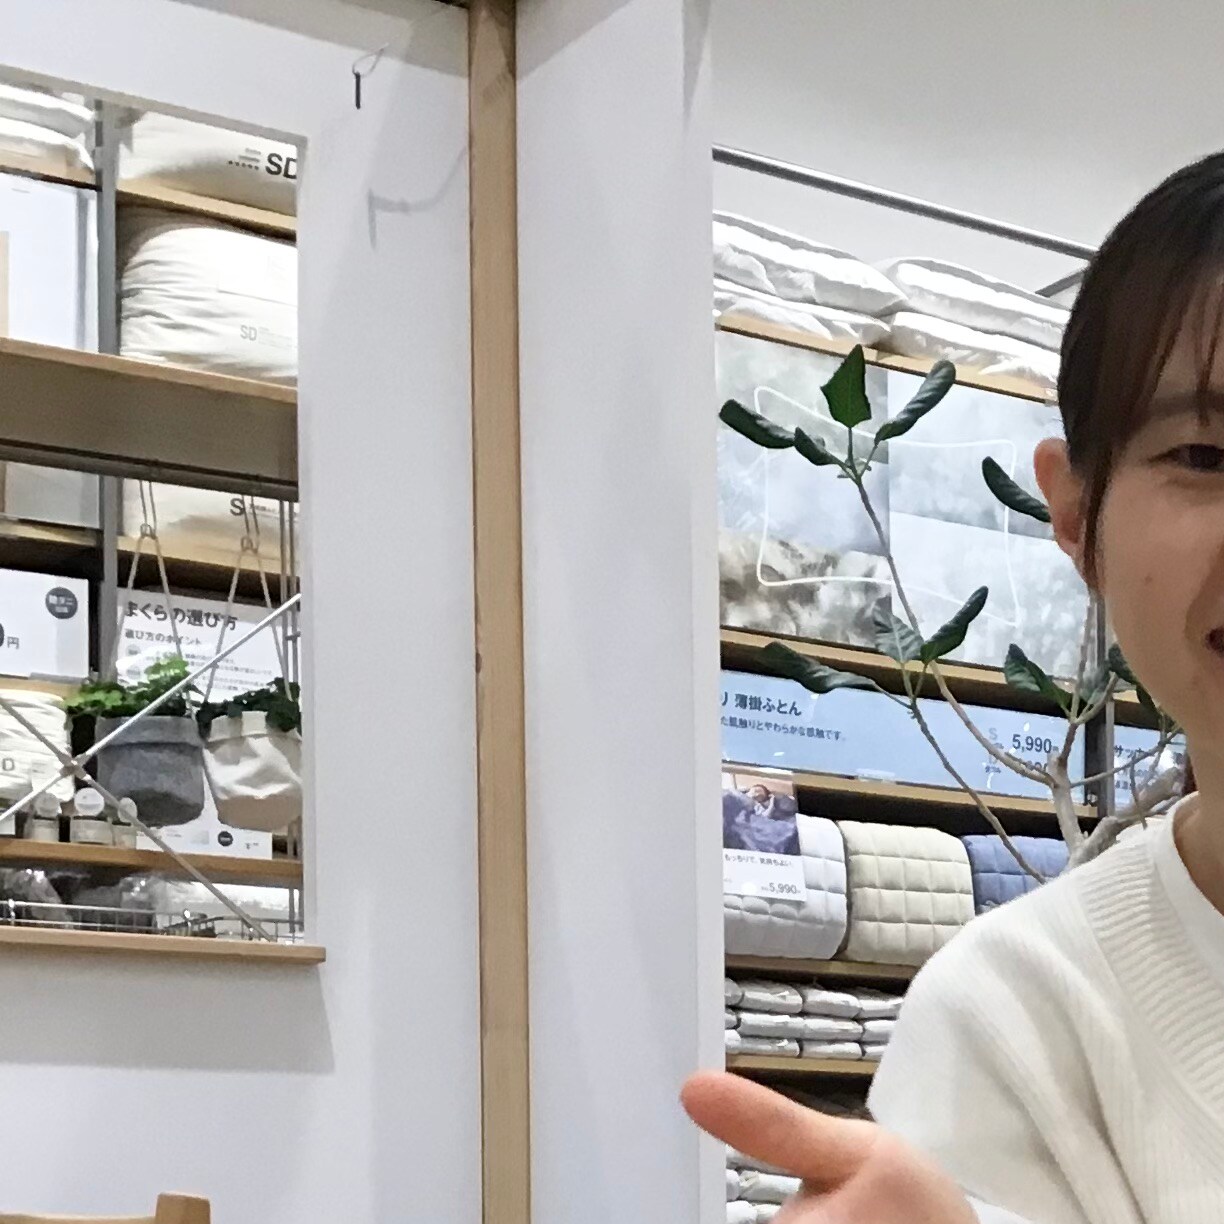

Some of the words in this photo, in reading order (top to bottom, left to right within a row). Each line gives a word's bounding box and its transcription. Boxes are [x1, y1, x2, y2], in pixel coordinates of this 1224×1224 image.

[126, 601, 238, 631] まくらの選び方
